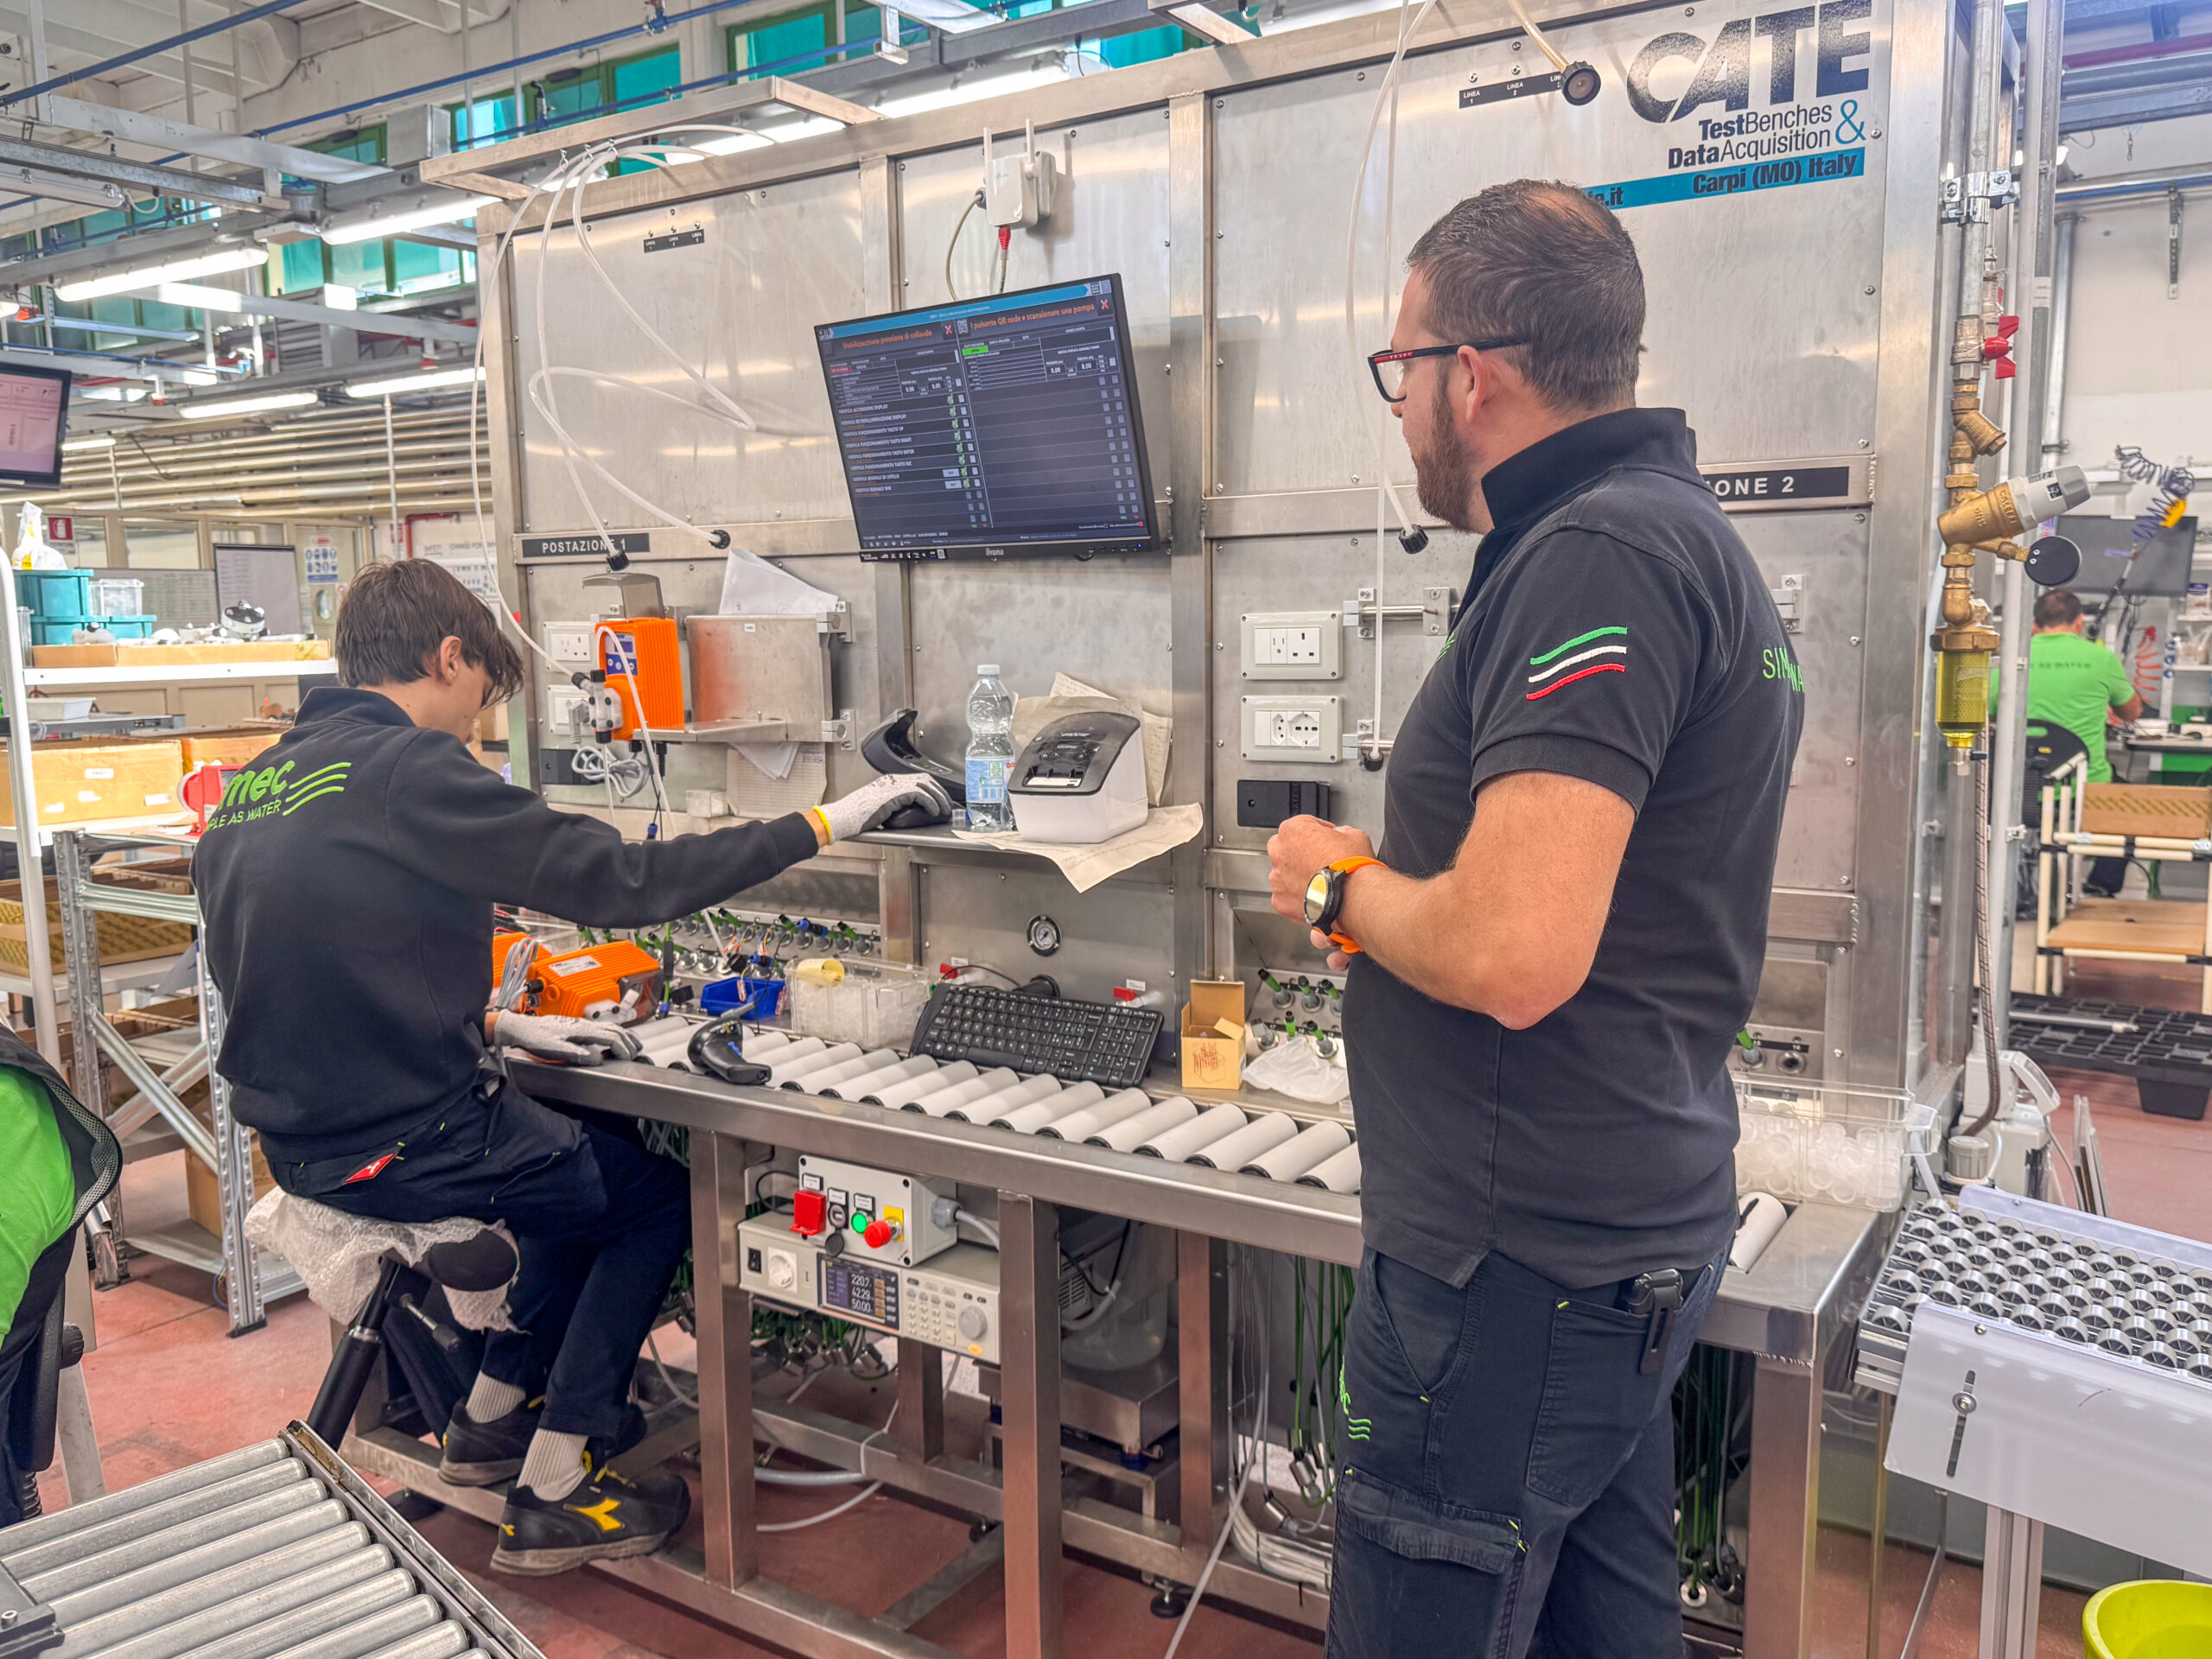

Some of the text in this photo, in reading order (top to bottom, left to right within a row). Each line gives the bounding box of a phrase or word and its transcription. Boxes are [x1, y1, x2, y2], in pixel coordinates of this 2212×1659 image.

[1627, 0, 1872, 124] CATE
[1507, 82, 1523, 91] LINEA
[1699, 99, 1866, 144] TestBenches &
[1669, 129, 1831, 169] DataAcquisition
[1693, 154, 1858, 194] Carpi (MO) Italy
[997, 316, 1007, 325] QR
[1007, 315, 1021, 323] code
[1706, 476, 1795, 497] ONE 2
[620, 538, 626, 550] 1
[207, 799, 283, 831] PLE AS WATER
